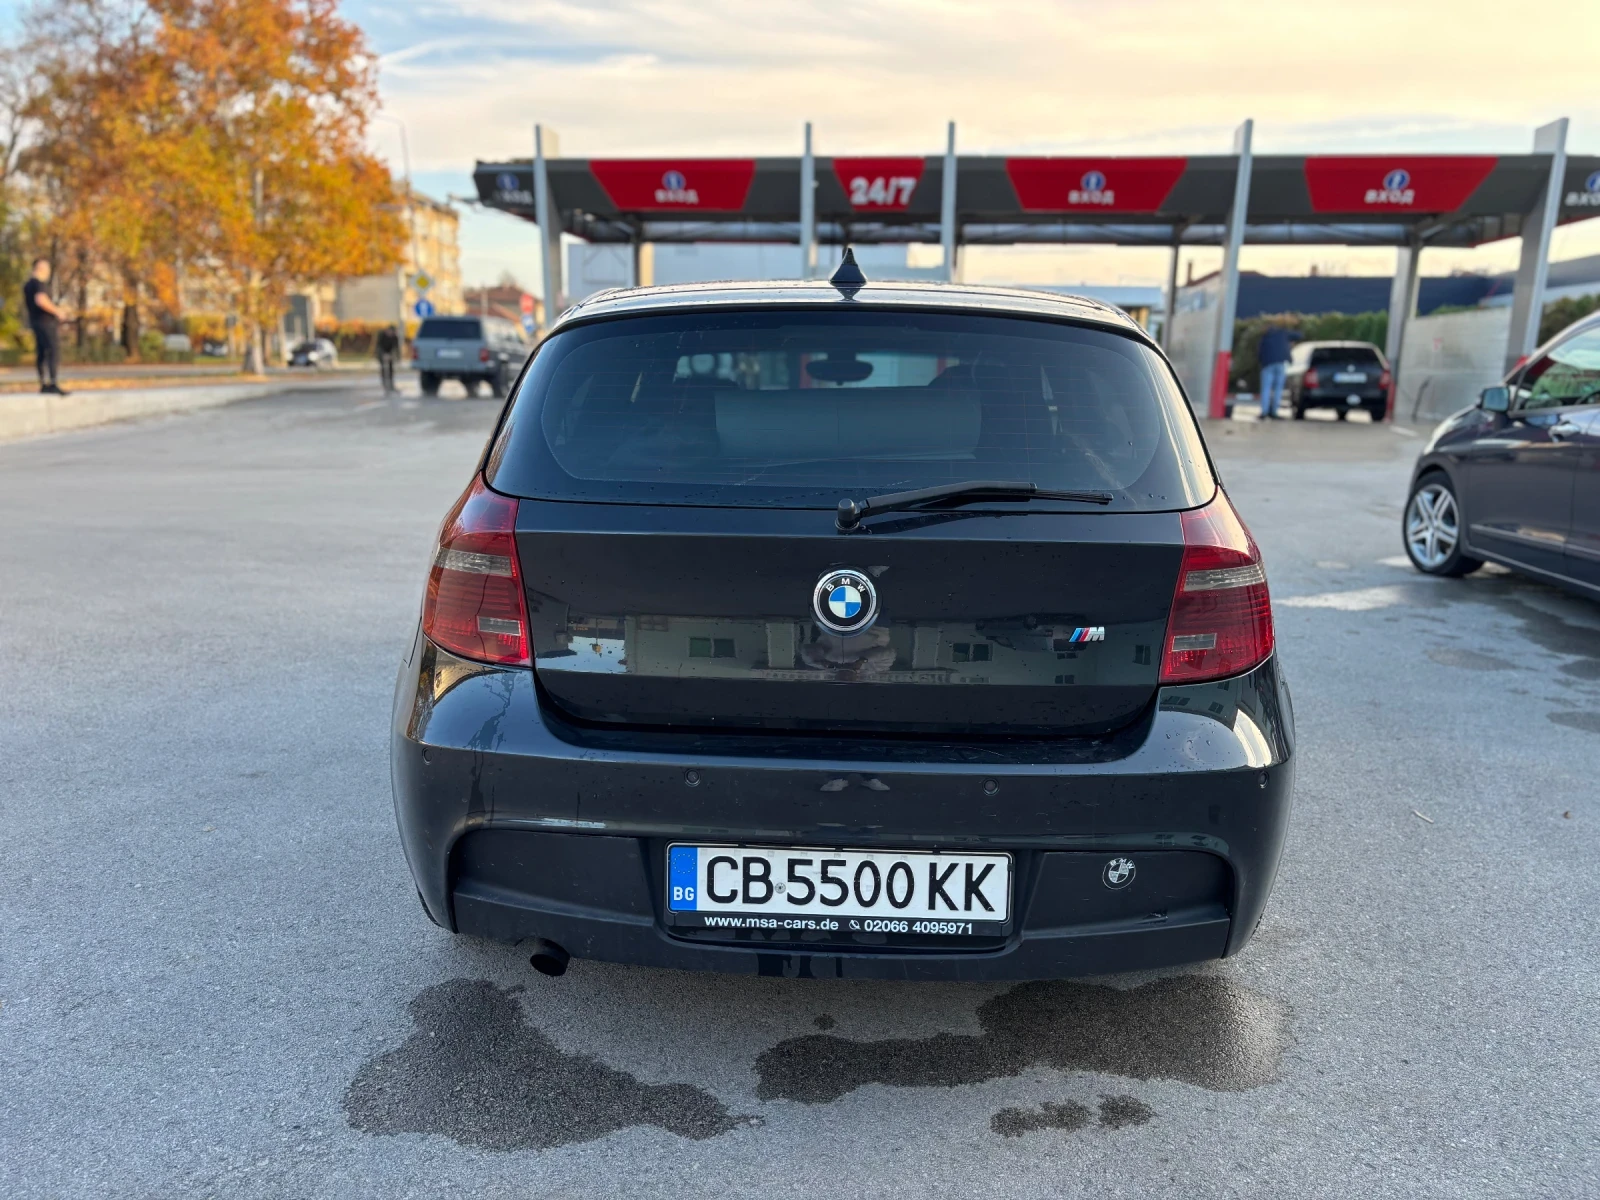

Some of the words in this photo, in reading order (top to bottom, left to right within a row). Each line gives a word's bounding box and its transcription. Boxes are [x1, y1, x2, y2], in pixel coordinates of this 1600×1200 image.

[850, 176, 917, 205] 24/7
[825, 578, 866, 592] BMW
[786, 858, 915, 910] 5500
[928, 862, 997, 912] KK
[673, 886, 695, 901] BG
[704, 916, 839, 930] www.msa-cars.de
[864, 919, 908, 933] 02066
[912, 921, 973, 935] 4095971
